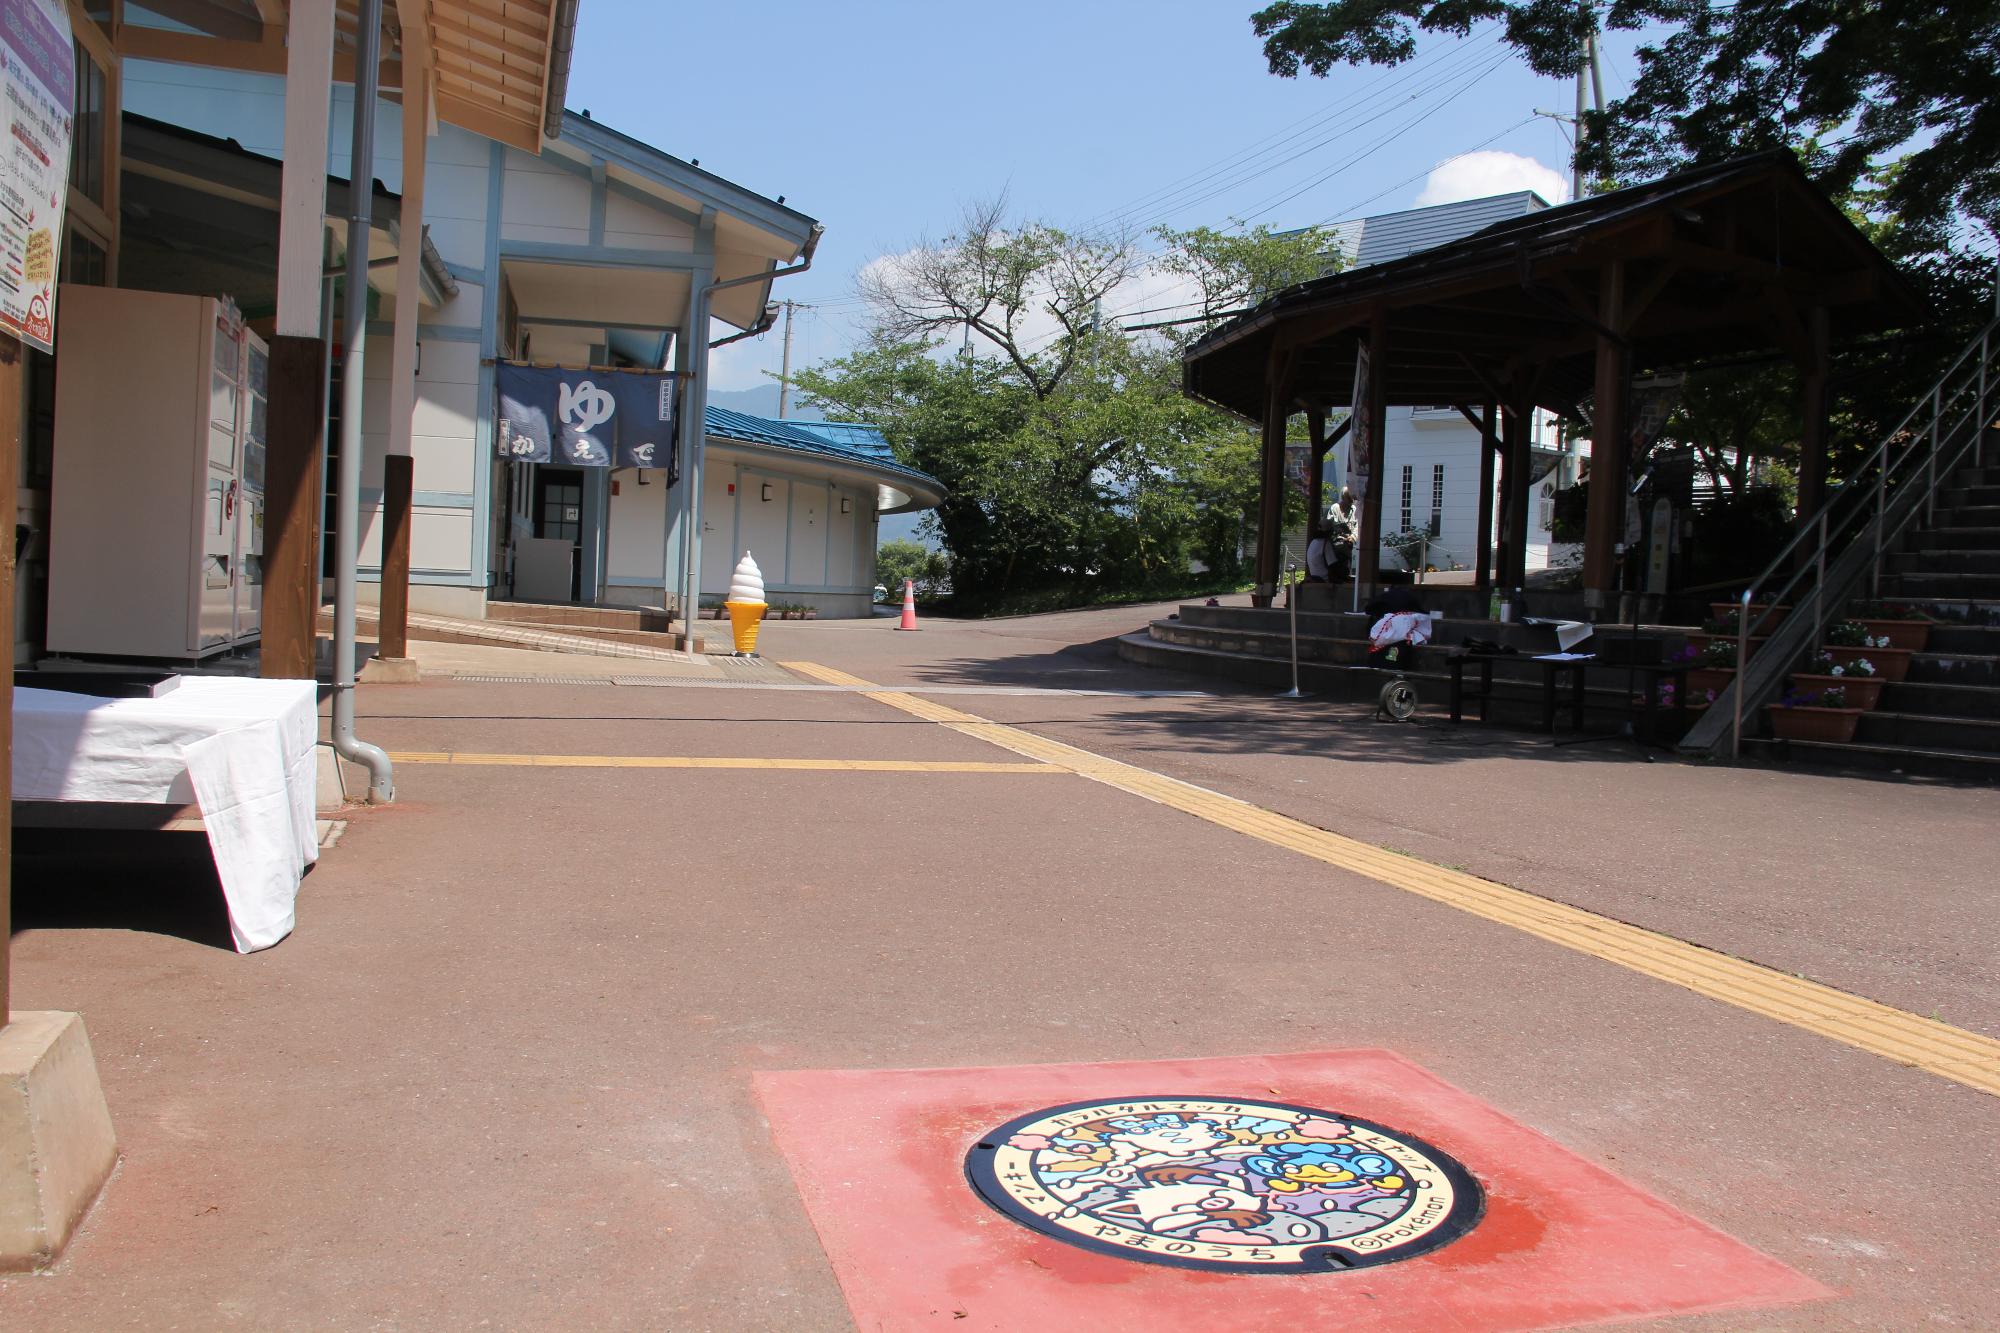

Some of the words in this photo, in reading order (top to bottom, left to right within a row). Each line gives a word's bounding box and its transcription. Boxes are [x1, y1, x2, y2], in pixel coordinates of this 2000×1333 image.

[559, 381, 615, 432] ゆ
[1366, 1136, 1437, 1173] ヒヤップ
[1003, 1162, 1046, 1205] マンキー
[1094, 1224, 1275, 1261] やまのうち
